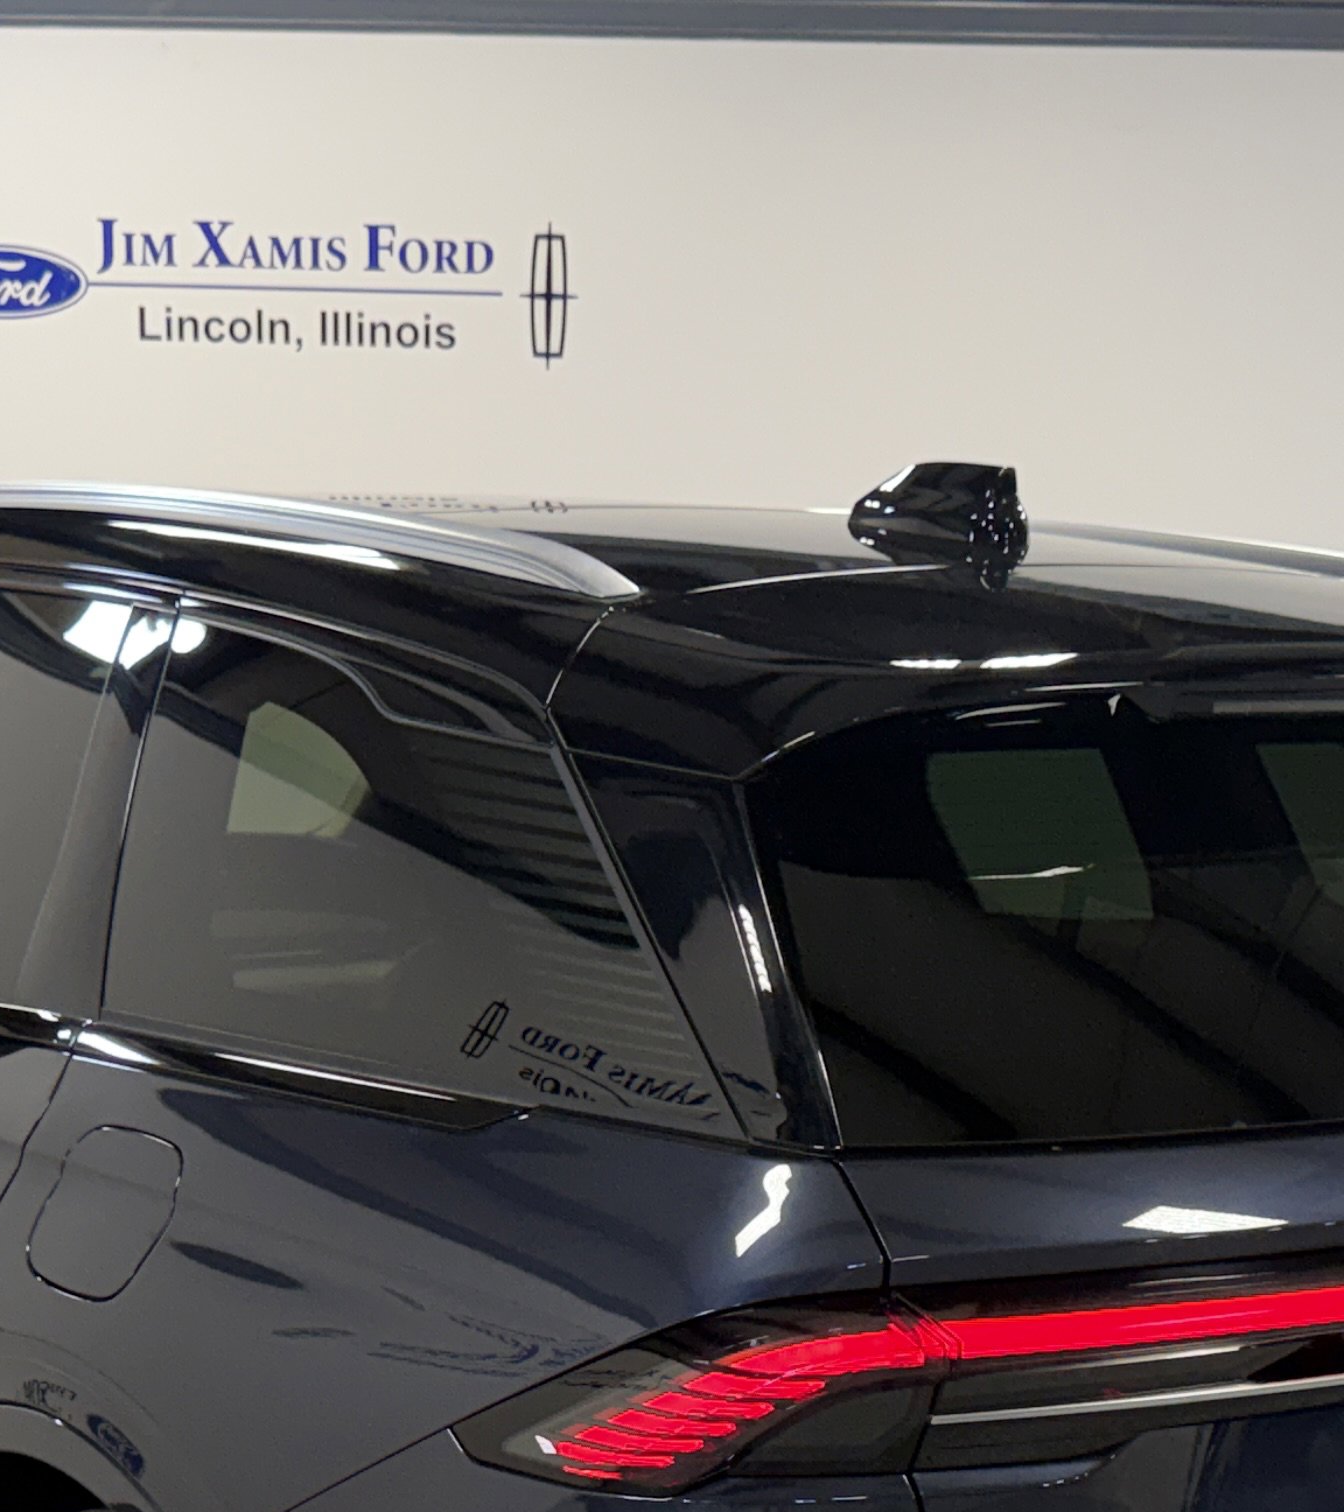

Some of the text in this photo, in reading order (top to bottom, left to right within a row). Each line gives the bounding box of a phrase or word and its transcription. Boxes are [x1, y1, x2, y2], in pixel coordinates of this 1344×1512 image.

[97, 218, 494, 275] JIM XAMIS FORD
[138, 305, 456, 352] Lincoln, Illinois
